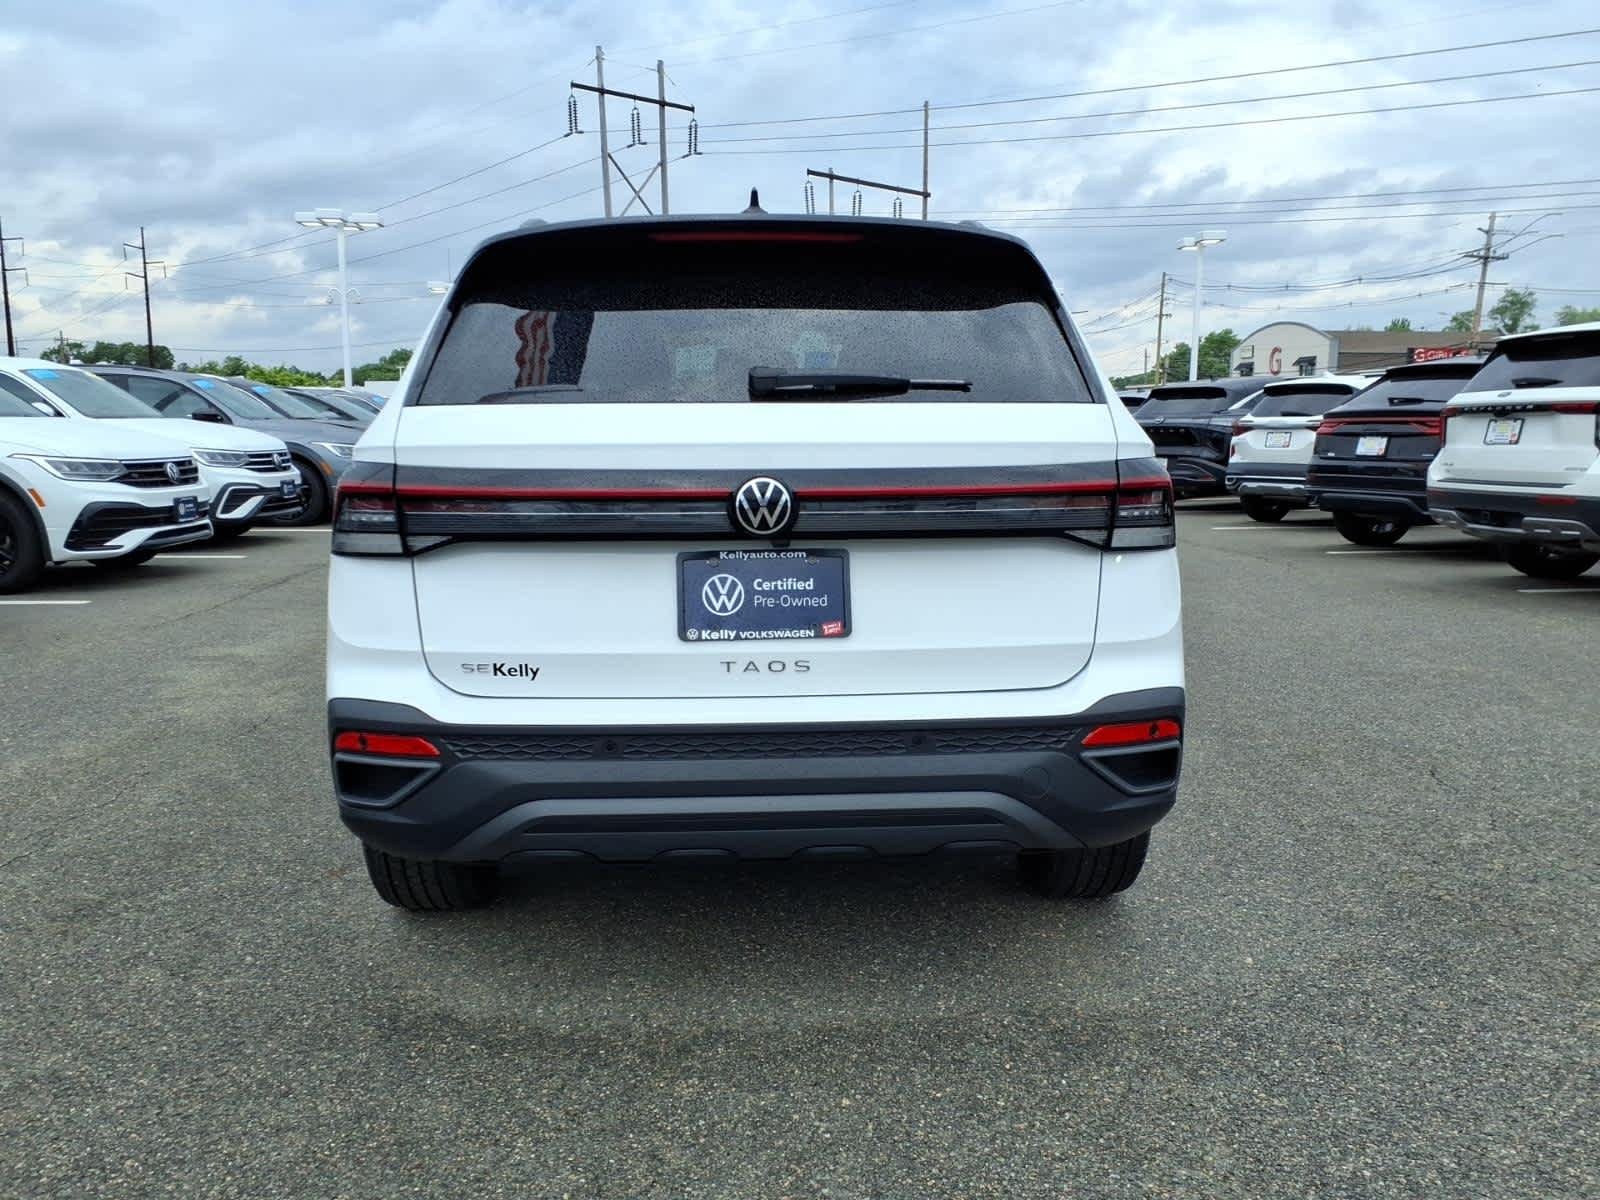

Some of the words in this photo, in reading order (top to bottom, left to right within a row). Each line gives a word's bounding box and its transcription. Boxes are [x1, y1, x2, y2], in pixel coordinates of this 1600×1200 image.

[1269, 346, 1282, 376] G
[735, 477, 792, 534] VW
[719, 551, 807, 561] Kellyauto.com
[753, 578, 814, 591] Certified
[702, 573, 745, 616] VW
[753, 595, 828, 608] Pre-Owned
[701, 629, 737, 641] Kelly
[739, 629, 815, 640] VOLKSWAGEN
[461, 663, 490, 674] SE
[493, 662, 540, 681] Kelly
[720, 660, 811, 673] TAOS
